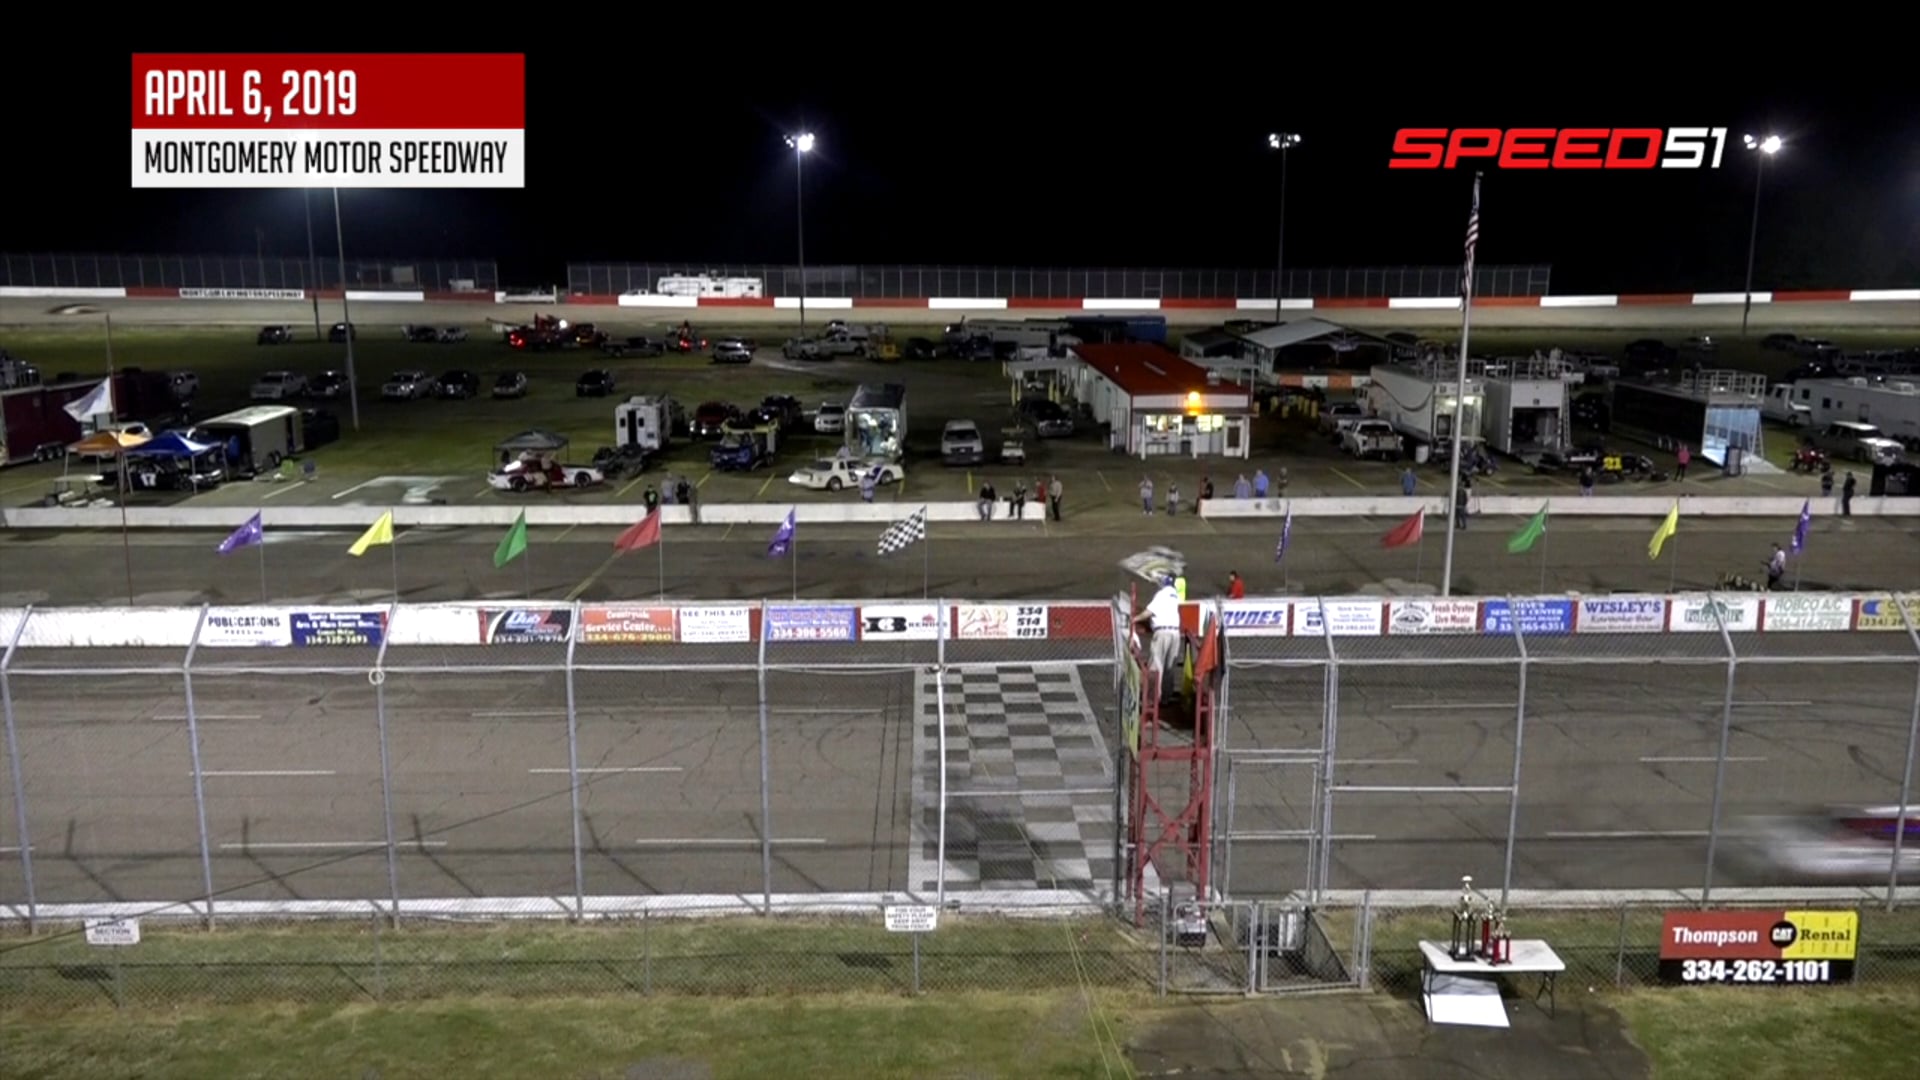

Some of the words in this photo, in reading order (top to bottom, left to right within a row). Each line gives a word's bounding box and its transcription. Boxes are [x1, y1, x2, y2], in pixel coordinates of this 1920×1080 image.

[1584, 601, 1661, 613] WESLEY'S
[208, 616, 281, 627] PUBLICATIONS
[586, 622, 622, 631] Service
[1017, 617, 1040, 626] 514
[1672, 927, 1758, 947] Thompson
[1772, 928, 1793, 941] CAT
[1800, 929, 1851, 941] Rental
[1682, 960, 1829, 981] 334-262-1101
